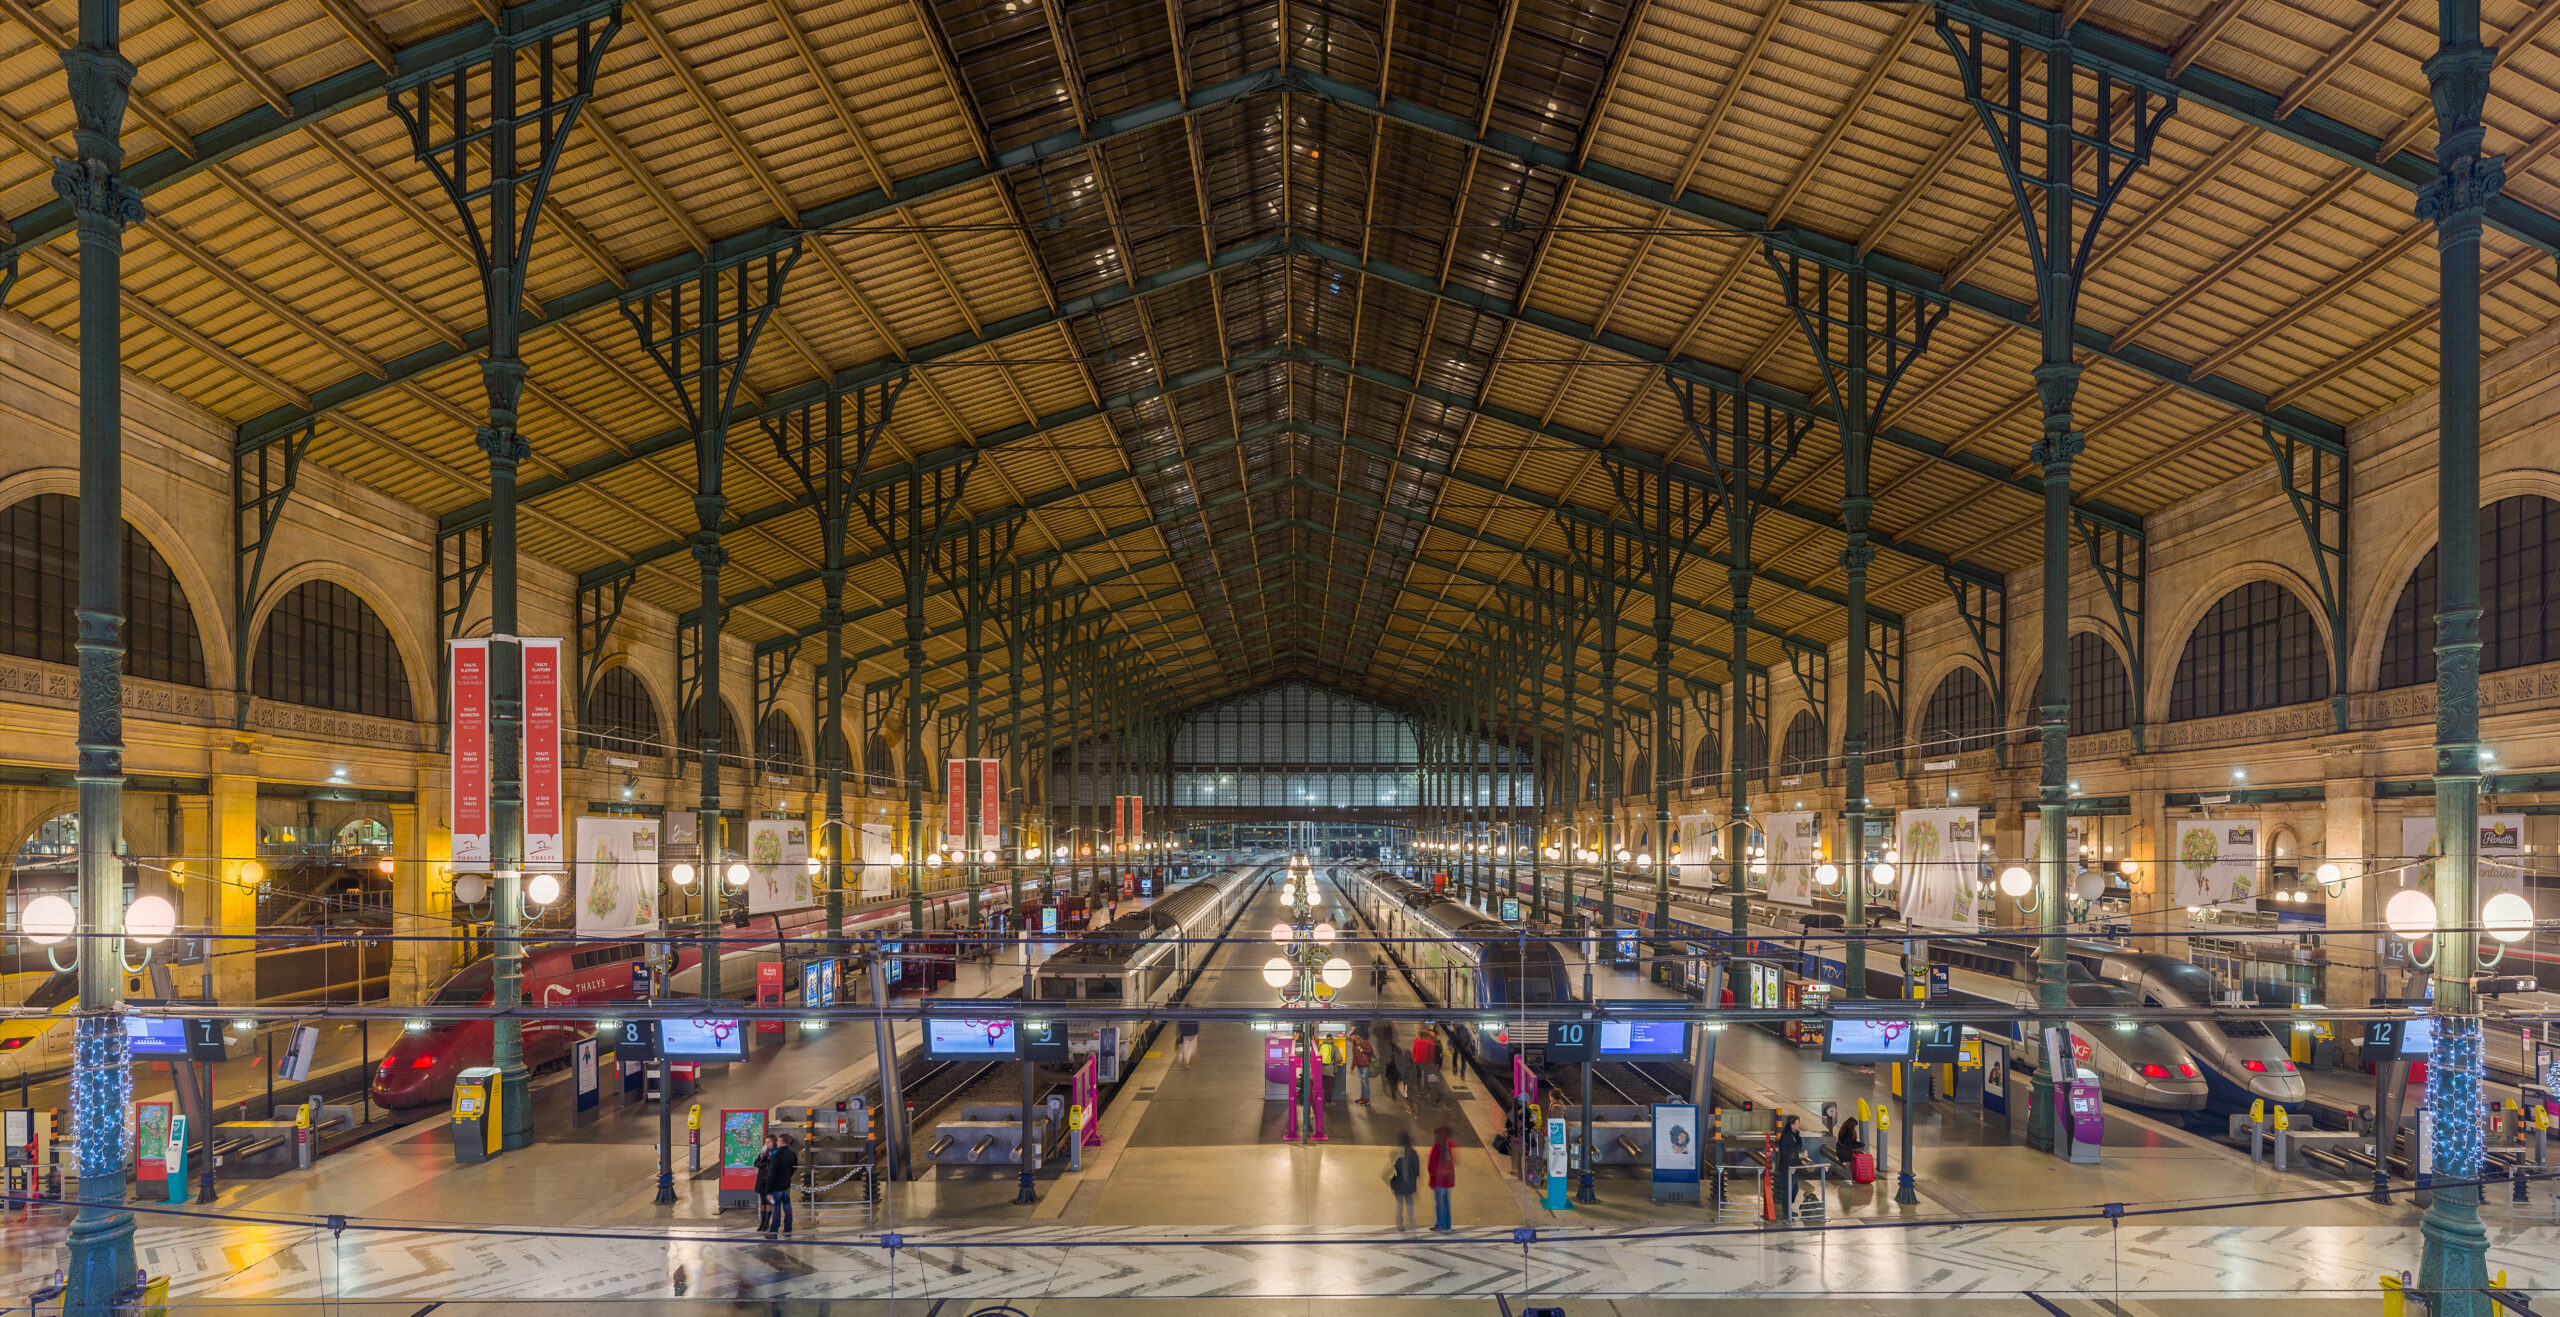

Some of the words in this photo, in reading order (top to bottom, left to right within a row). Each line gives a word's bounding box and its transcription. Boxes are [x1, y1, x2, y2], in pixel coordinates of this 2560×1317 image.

[2482, 832, 2515, 844] Florette
[2479, 866, 2518, 878] antaisie
[187, 942, 196, 957] 7
[651, 943, 657, 958] 8
[1915, 944, 1924, 960] 11
[2390, 942, 2404, 958] 12
[1822, 965, 1842, 979] TGV
[576, 978, 606, 993] THALYS
[201, 1024, 211, 1042] 7
[626, 1023, 638, 1041] 8
[1040, 1026, 1052, 1042] 9
[1558, 1024, 1583, 1042] 10
[1933, 1025, 1952, 1043] 11
[2373, 1022, 2392, 1041] 12
[2071, 1043, 2090, 1057] NCF
